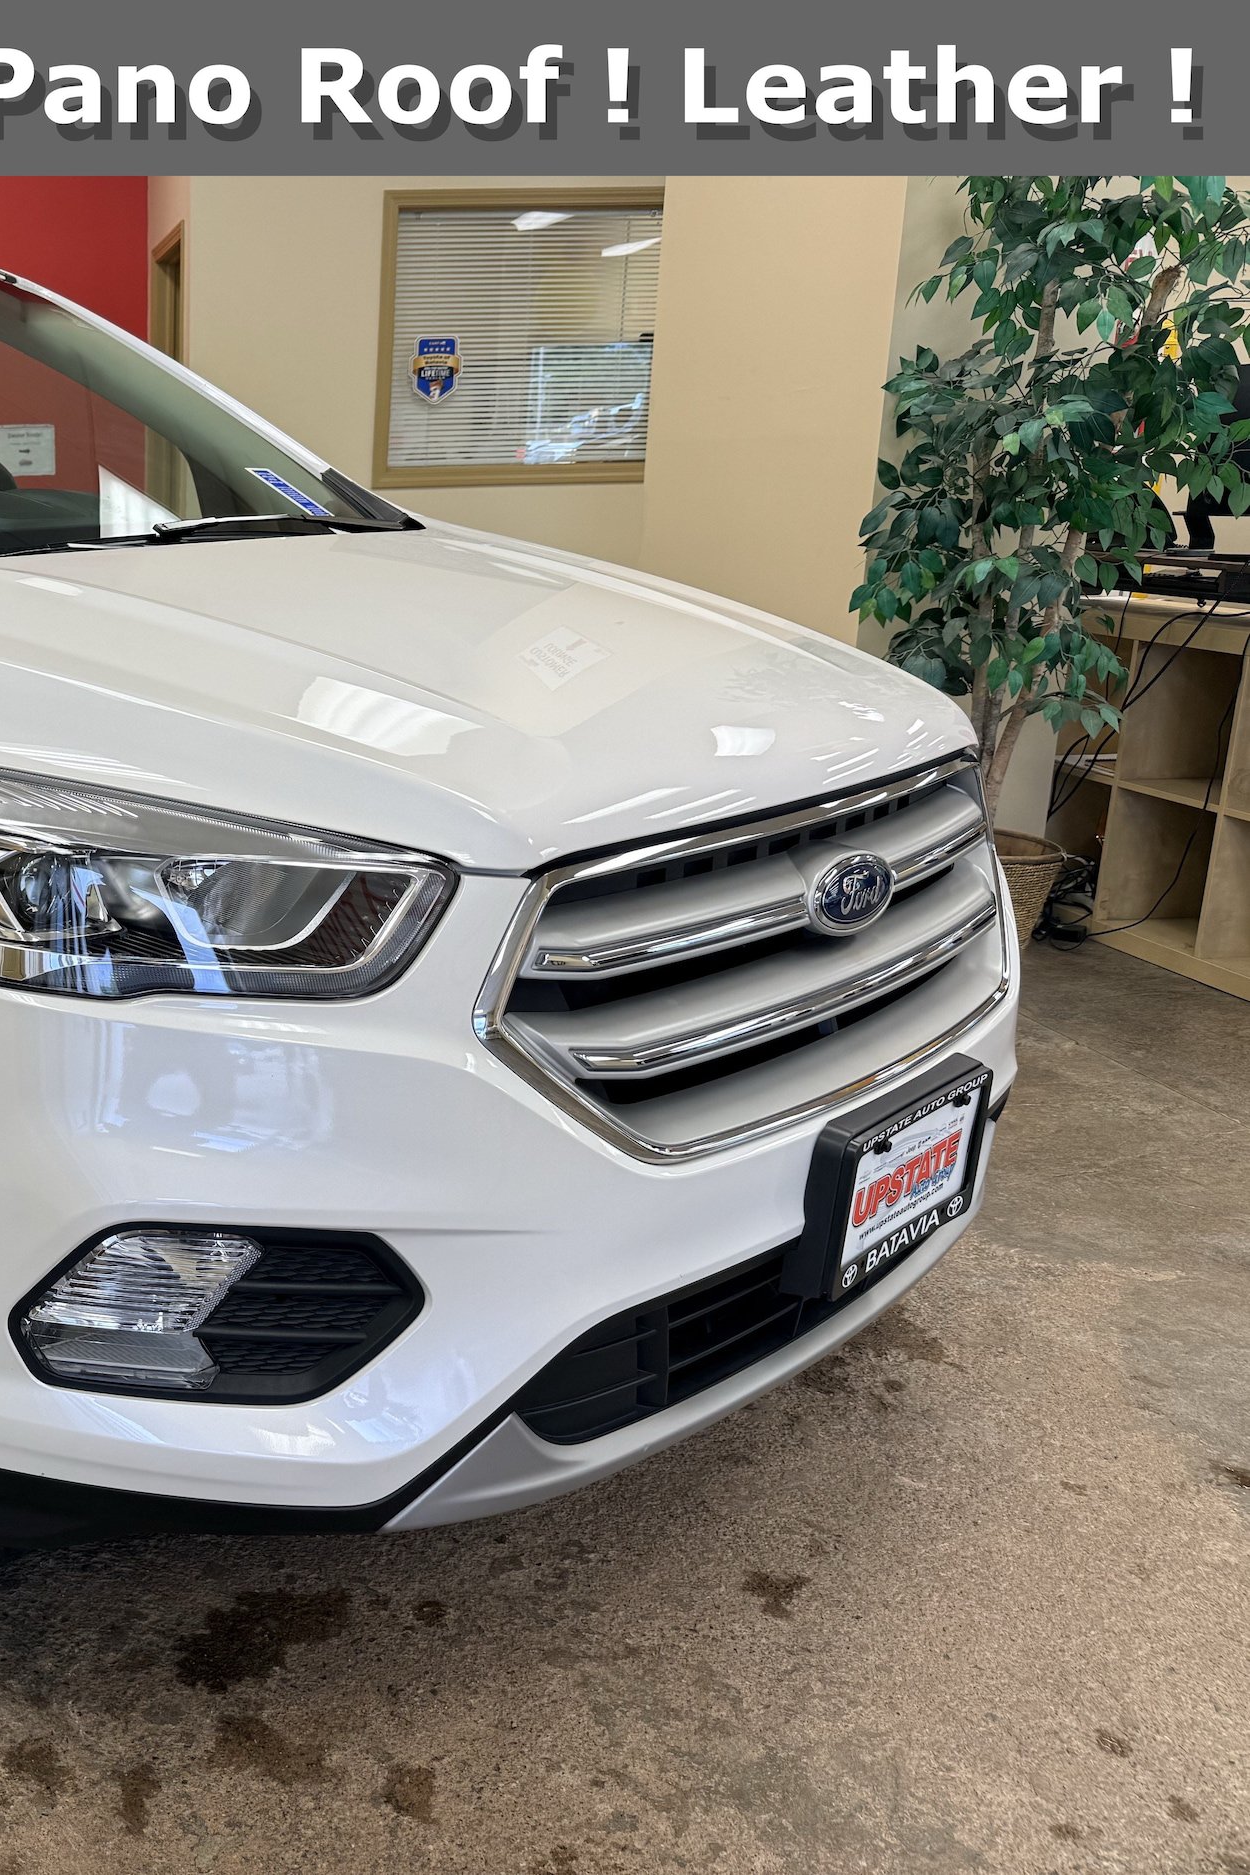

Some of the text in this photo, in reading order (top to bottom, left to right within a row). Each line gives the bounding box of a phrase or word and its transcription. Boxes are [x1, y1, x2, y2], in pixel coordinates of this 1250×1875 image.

[841, 871, 881, 915] Ford
[863, 1116, 912, 1153] UPSTATE
[913, 1096, 946, 1121] AUTO
[947, 1073, 989, 1101] GROUP
[852, 1128, 963, 1227] UPSTATE
[859, 1183, 944, 1241] www.upstateautogroup.com
[865, 1209, 940, 1273] BATAVIA
